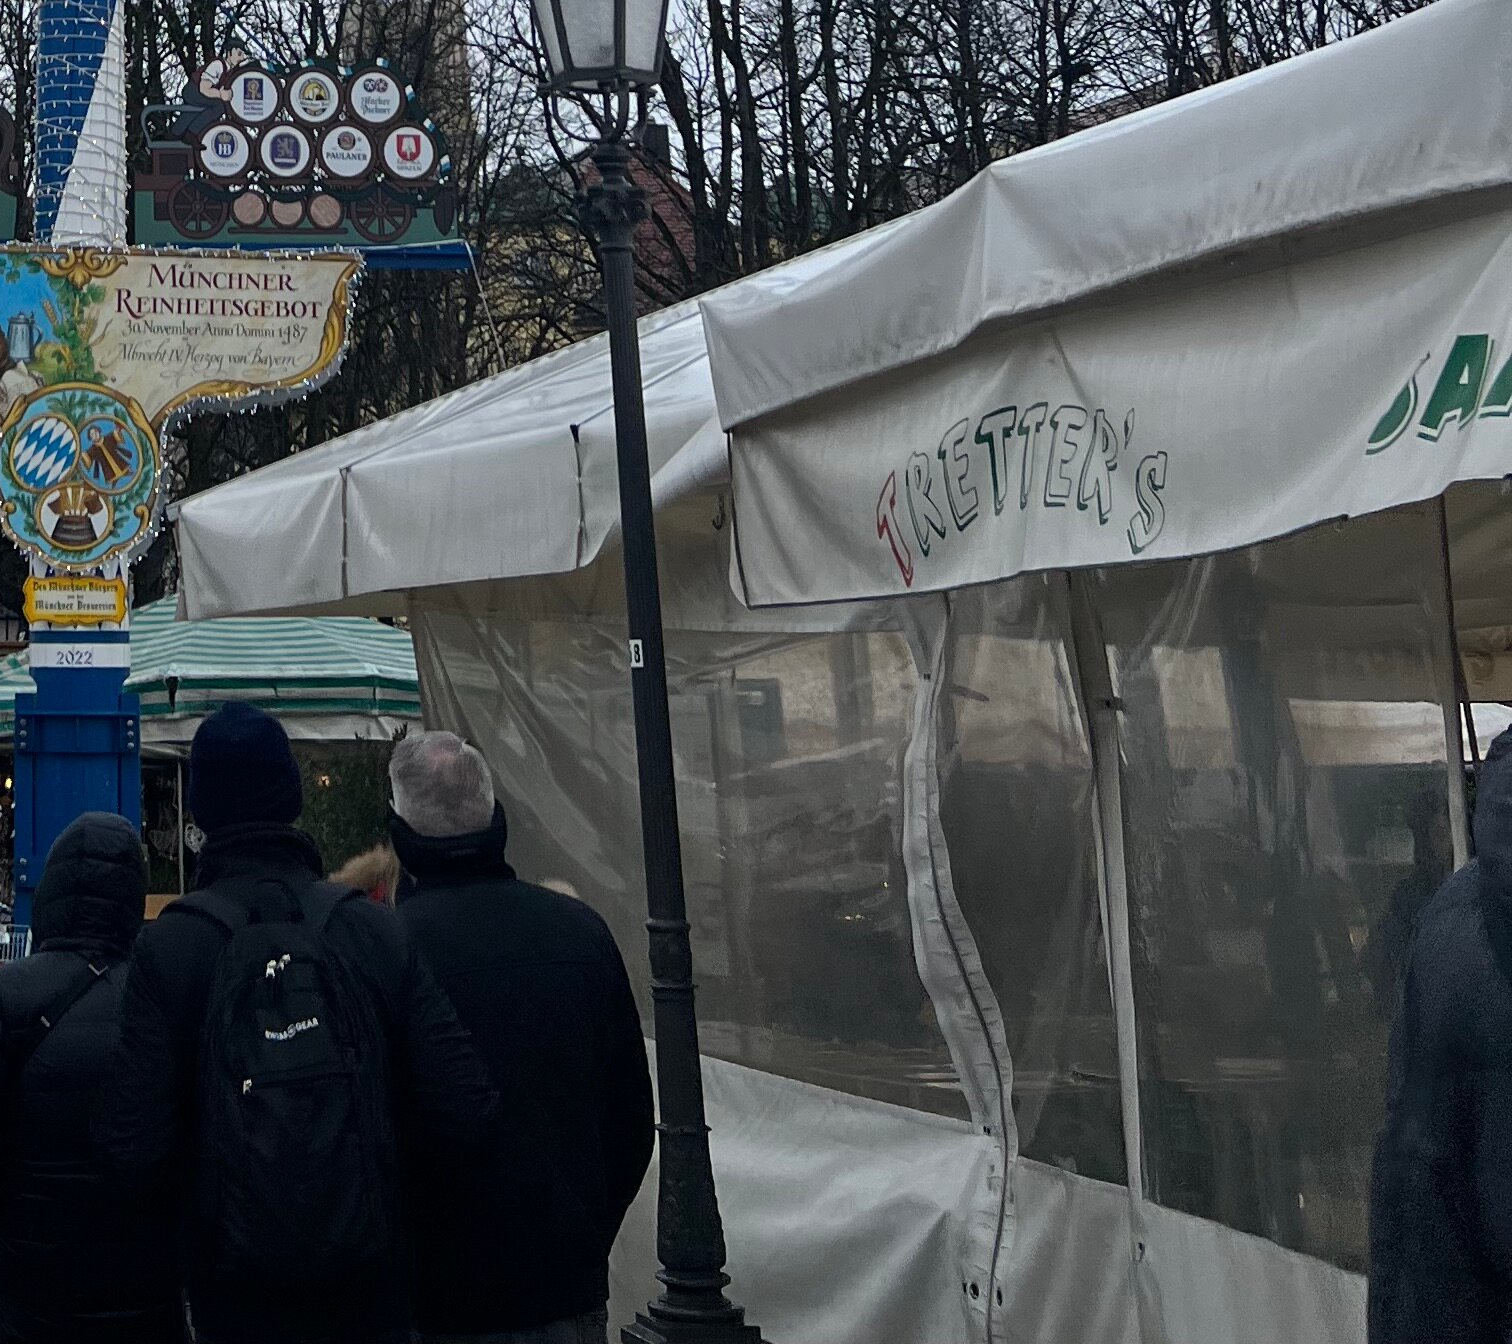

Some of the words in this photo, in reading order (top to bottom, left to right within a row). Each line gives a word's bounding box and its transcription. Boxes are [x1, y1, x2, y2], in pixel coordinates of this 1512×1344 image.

[218, 144, 232, 155] HB
[326, 152, 367, 161] PAULANER
[147, 263, 299, 293] MÜNCHNER
[115, 288, 323, 319] REINHEITSGEBOT
[143, 320, 200, 336] November
[201, 322, 233, 336] Anno
[233, 323, 274, 337] Domini
[279, 324, 308, 344] 1487
[120, 339, 169, 365] Albrecht
[182, 340, 224, 374] Herzog
[228, 355, 247, 365] von
[250, 343, 296, 368] Bayern
[876, 402, 1168, 588] TRETTER'S
[56, 650, 93, 665] 2022
